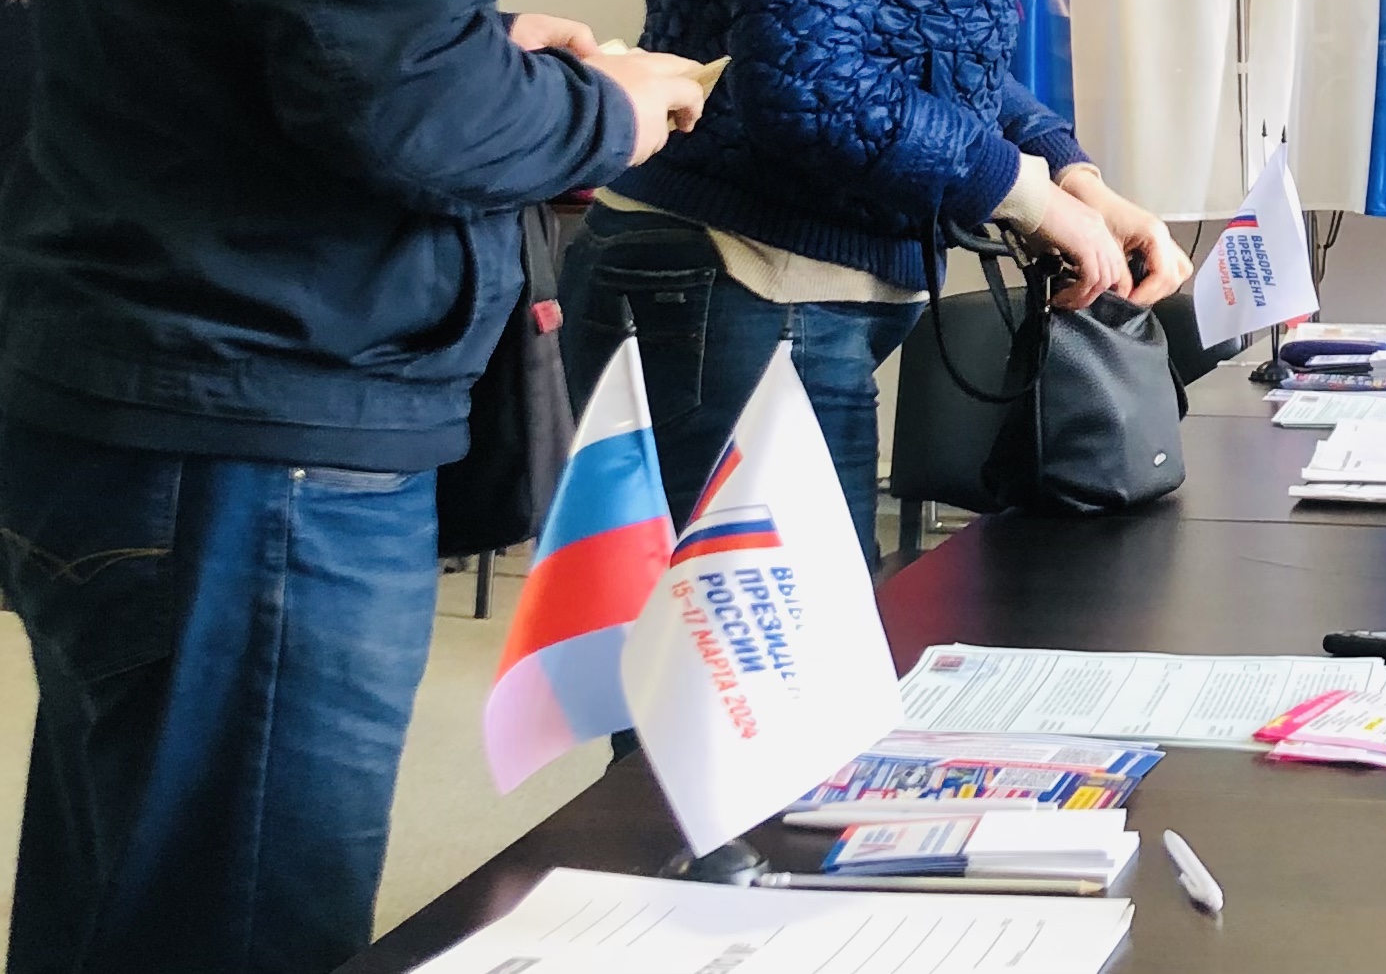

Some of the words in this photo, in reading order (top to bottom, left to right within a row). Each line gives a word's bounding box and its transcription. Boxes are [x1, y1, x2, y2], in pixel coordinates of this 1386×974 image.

[1226, 235, 1243, 279] РОССИИ
[1237, 235, 1266, 307] ПРЕЗИДЕНТА
[1251, 235, 1276, 287] ВЫБОРЫ
[697, 571, 767, 673] РОССИИ
[690, 629, 739, 692] МАРТА
